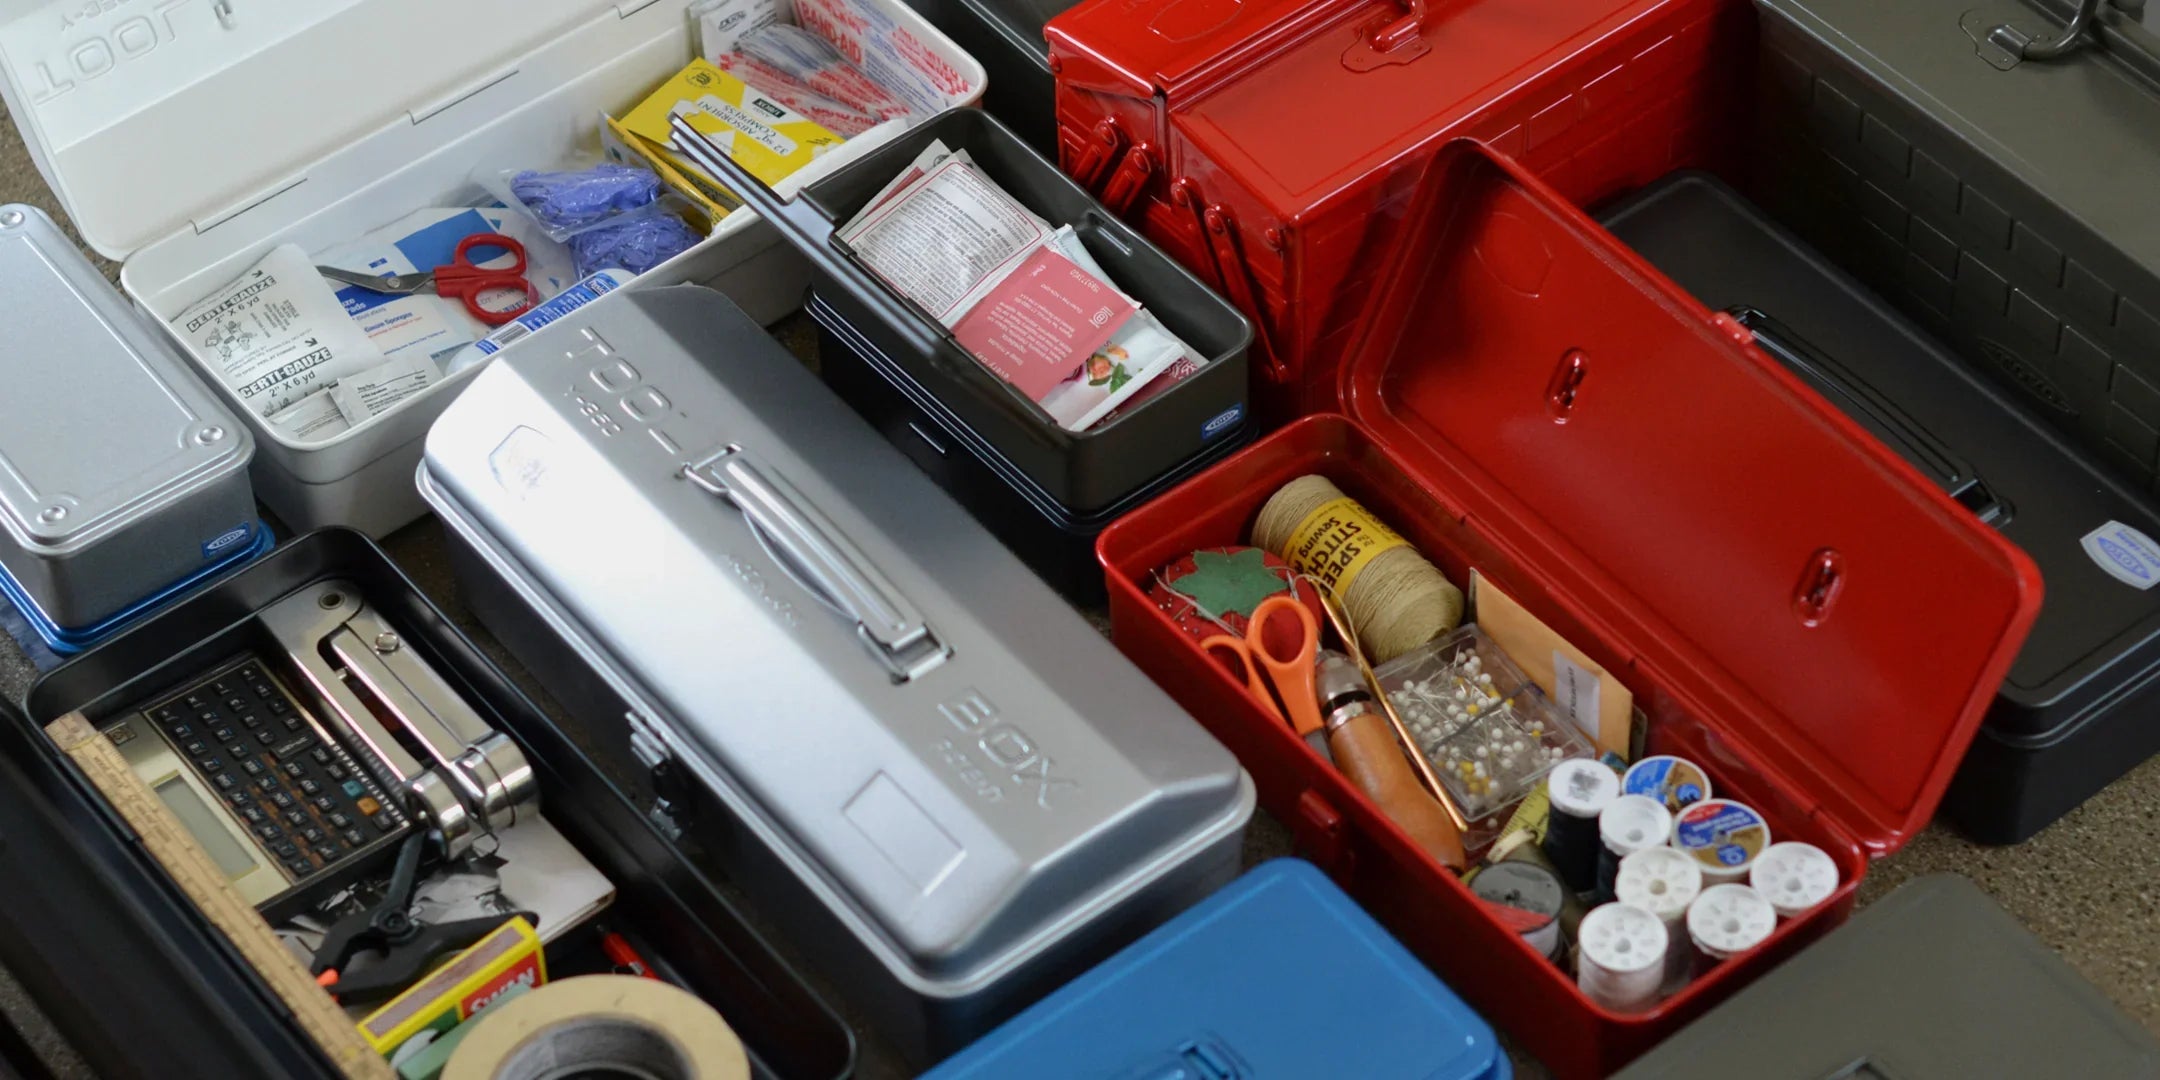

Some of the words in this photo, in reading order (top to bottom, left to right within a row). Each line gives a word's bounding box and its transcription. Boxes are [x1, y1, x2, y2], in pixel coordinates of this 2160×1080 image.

[694, 98, 757, 136] ABSORBENT
[721, 103, 778, 138] COMPRESS
[773, 143, 789, 156] 32
[186, 275, 277, 332] CERTI-GAUZE
[245, 294, 261, 308] yd
[238, 346, 332, 399] CERTI-GAUZE
[267, 384, 283, 398] 2"
[281, 379, 293, 391] X
[291, 376, 301, 387] 6
[300, 369, 317, 384] yd
[563, 324, 687, 456] TOOL
[1298, 517, 1340, 558] Sewing
[935, 684, 1080, 812] BOX
